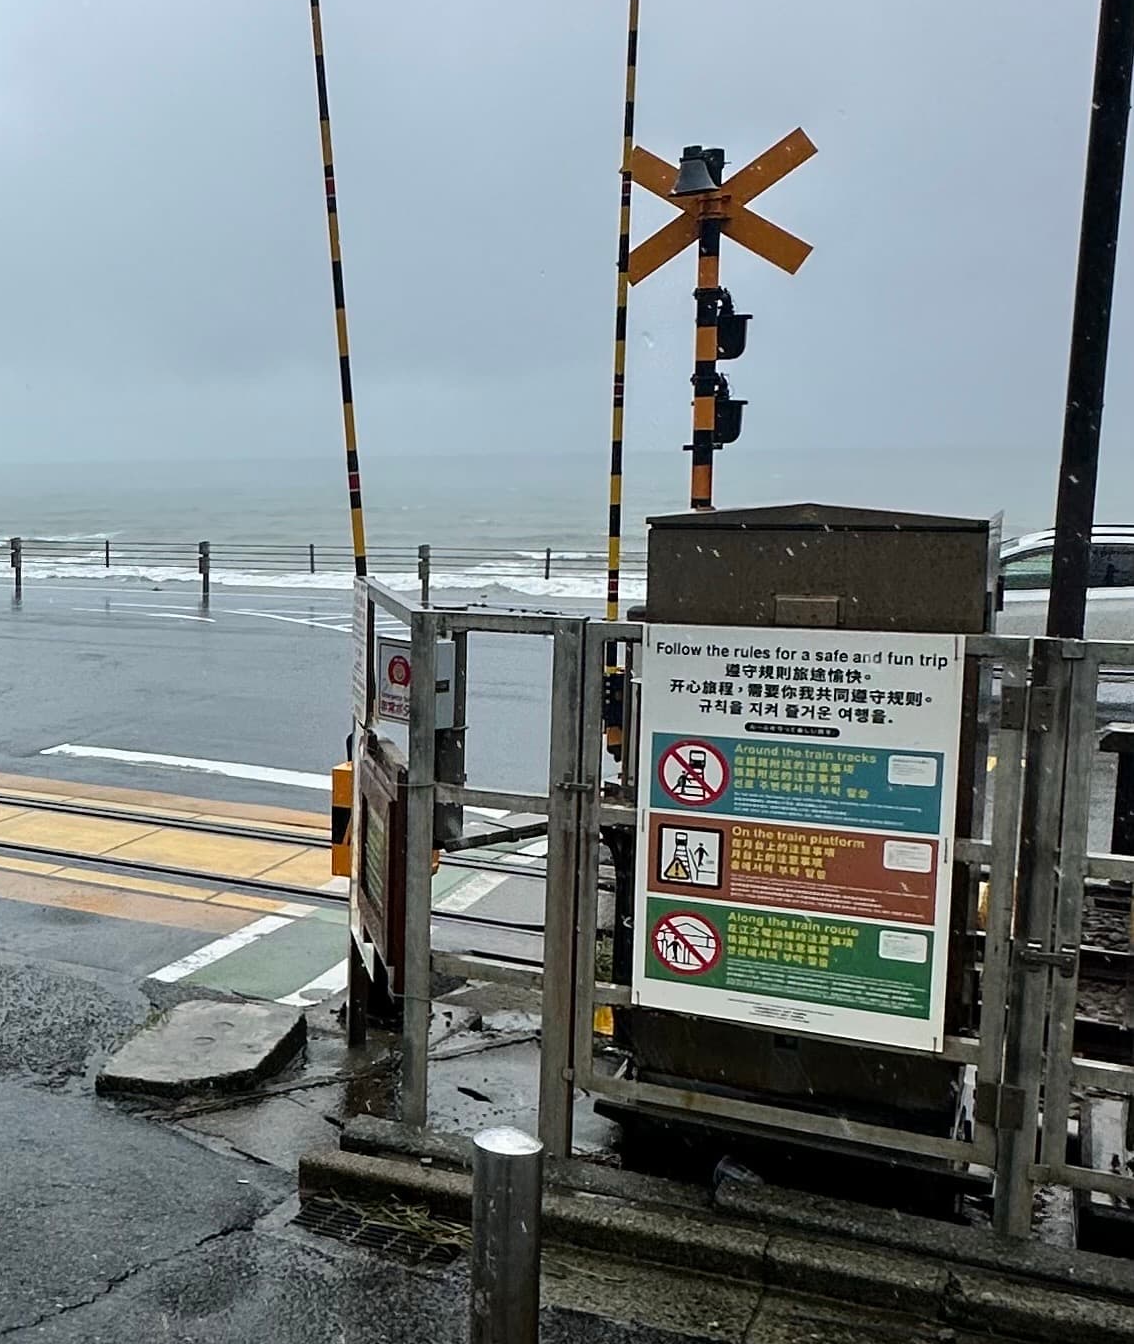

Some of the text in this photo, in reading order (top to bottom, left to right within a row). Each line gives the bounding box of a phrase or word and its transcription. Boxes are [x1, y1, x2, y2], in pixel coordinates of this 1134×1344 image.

[656, 642, 949, 670] Follow the rules for a safe and fun trip
[699, 699, 894, 725] 규칙을 지켜 즐거운 여행을.
[734, 743, 877, 764] Around the train tracks
[731, 825, 865, 849] On the train platform
[727, 911, 859, 937] Along the train route
